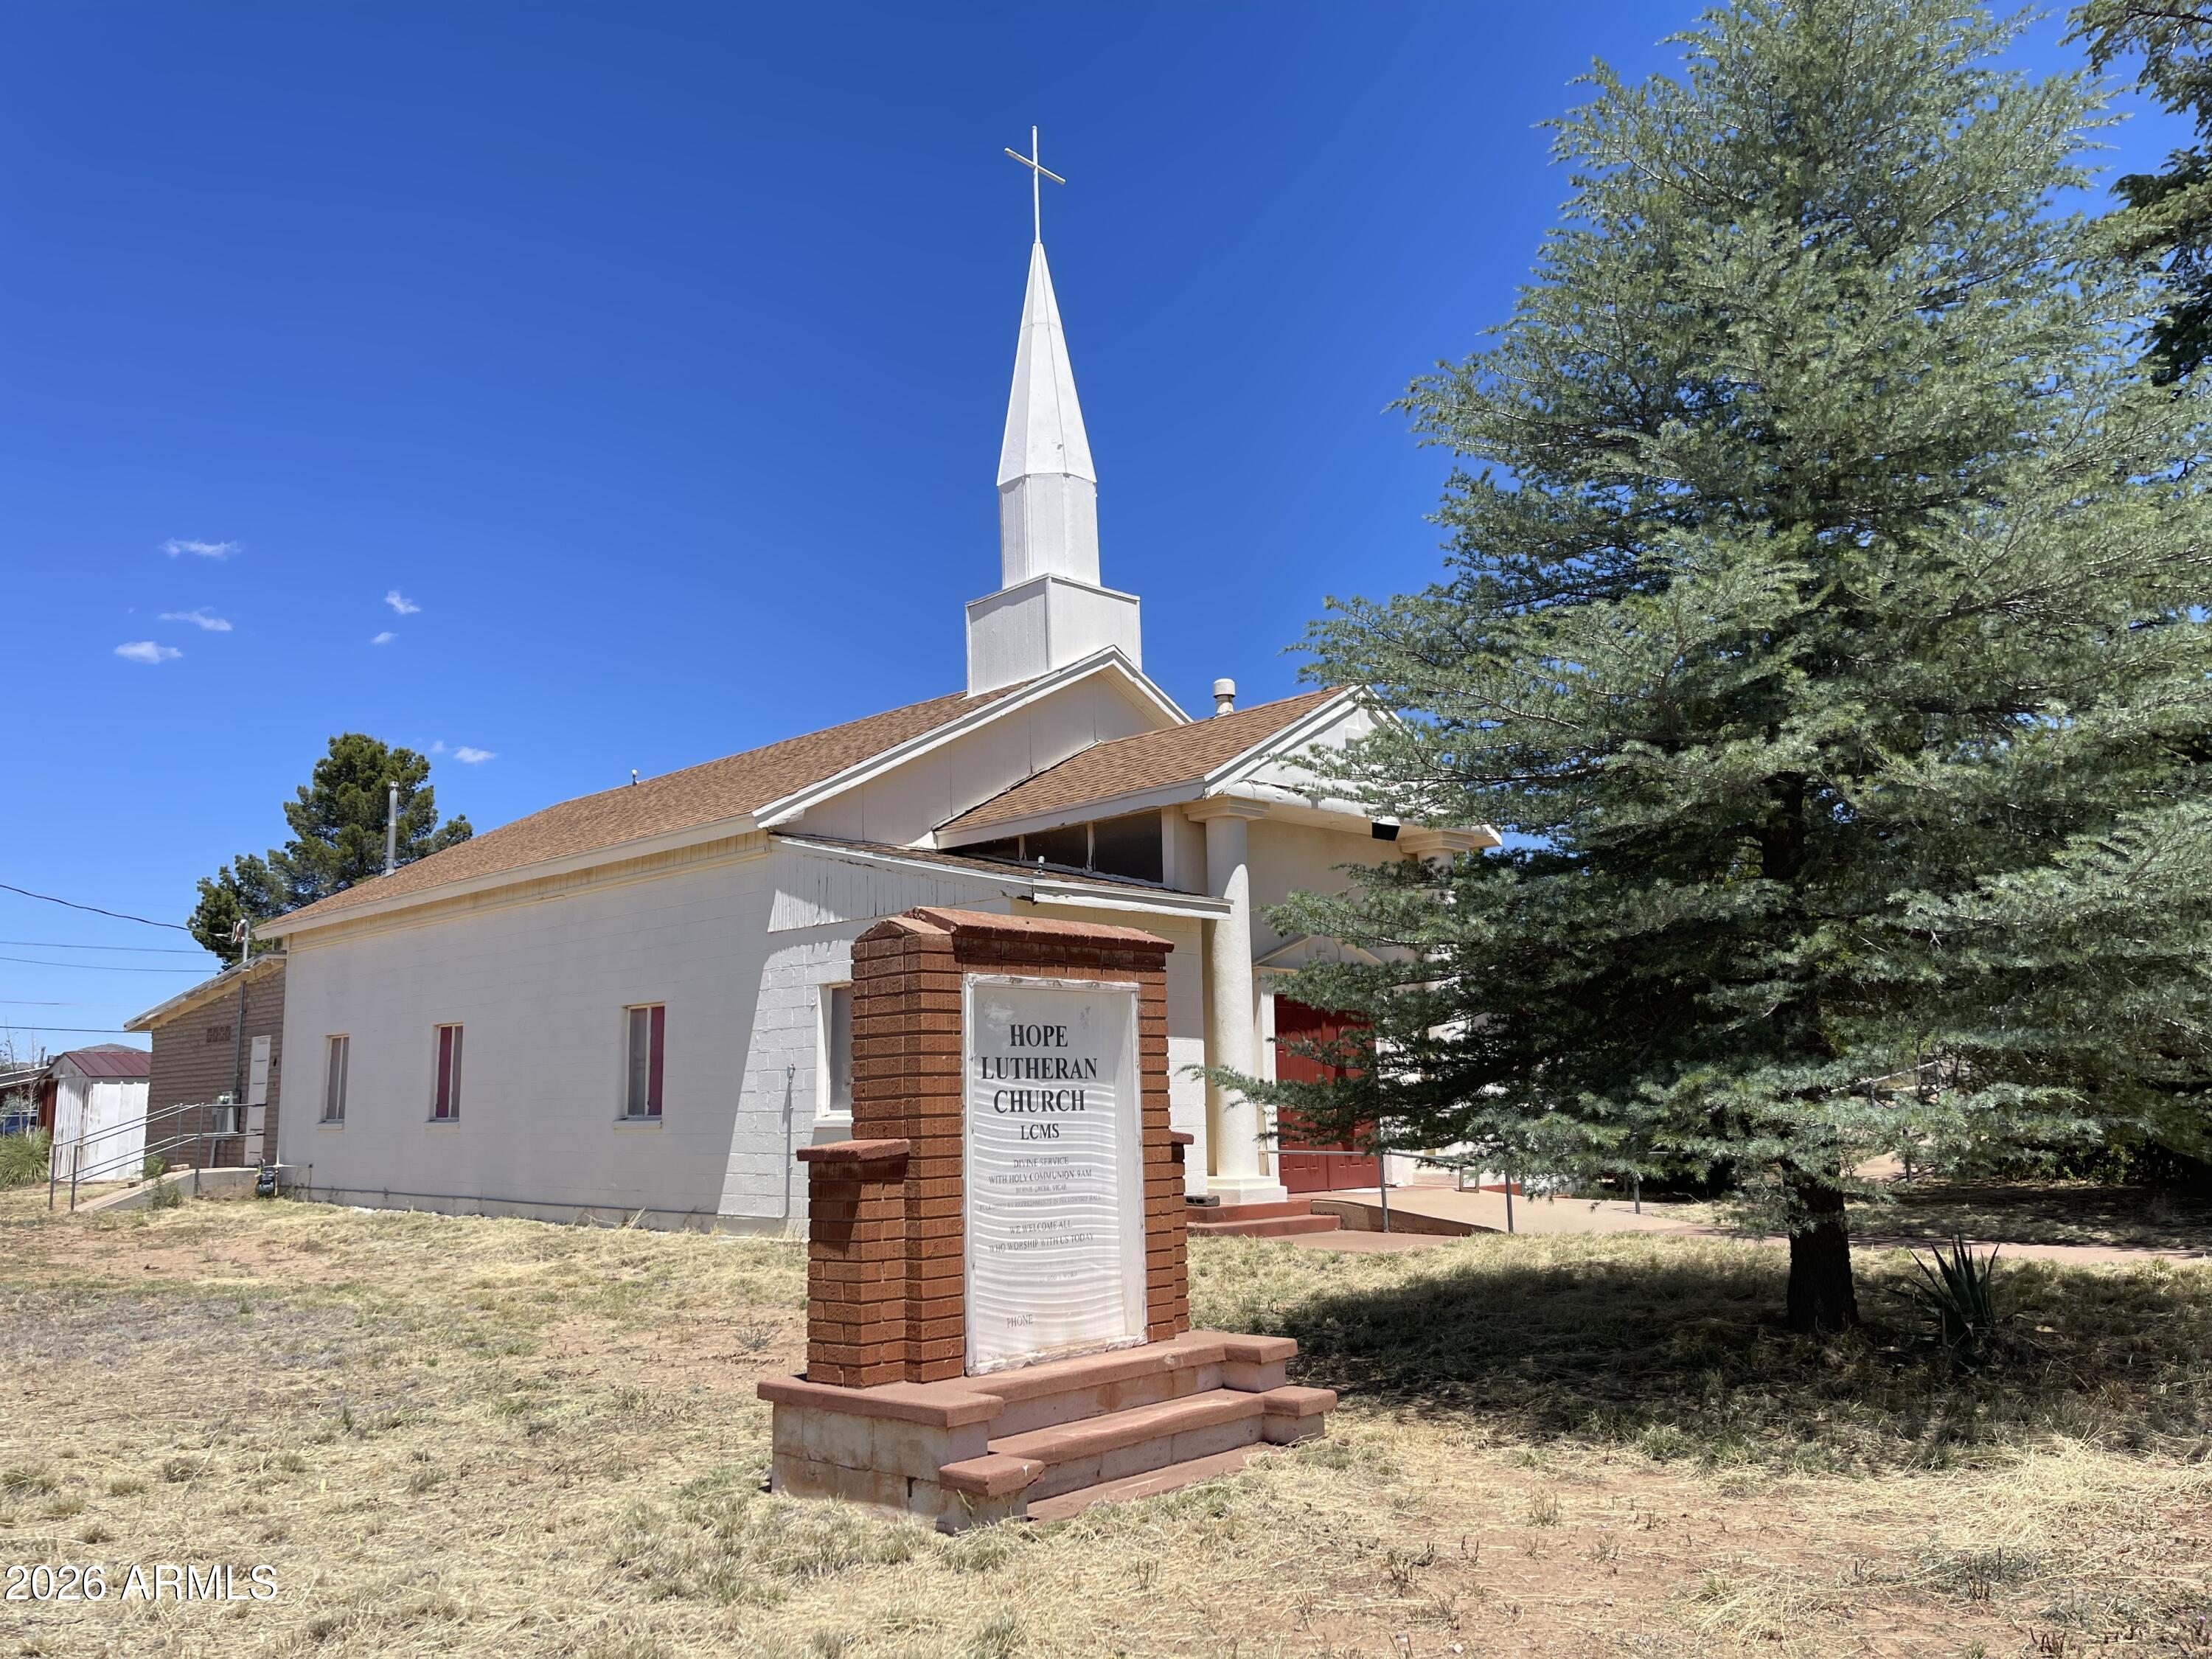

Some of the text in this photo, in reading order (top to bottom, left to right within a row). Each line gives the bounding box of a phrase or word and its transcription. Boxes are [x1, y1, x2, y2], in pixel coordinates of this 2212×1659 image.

[1009, 1024, 1068, 1047] HOPE
[981, 1057, 1097, 1079] LUTHERAN
[993, 1089, 1086, 1113] CHURCH
[1020, 1124, 1060, 1140] LCMS
[1013, 1156, 1069, 1169] DIVINE SERVICE
[989, 1169, 1092, 1185] WITH HOLY COMMUNION 9AM
[1009, 1220, 1072, 1235] WE WELCOME ALL
[989, 1232, 1094, 1253] WHO WORSHIP WITH US TODAY
[1006, 1314, 1034, 1329] PHONE
